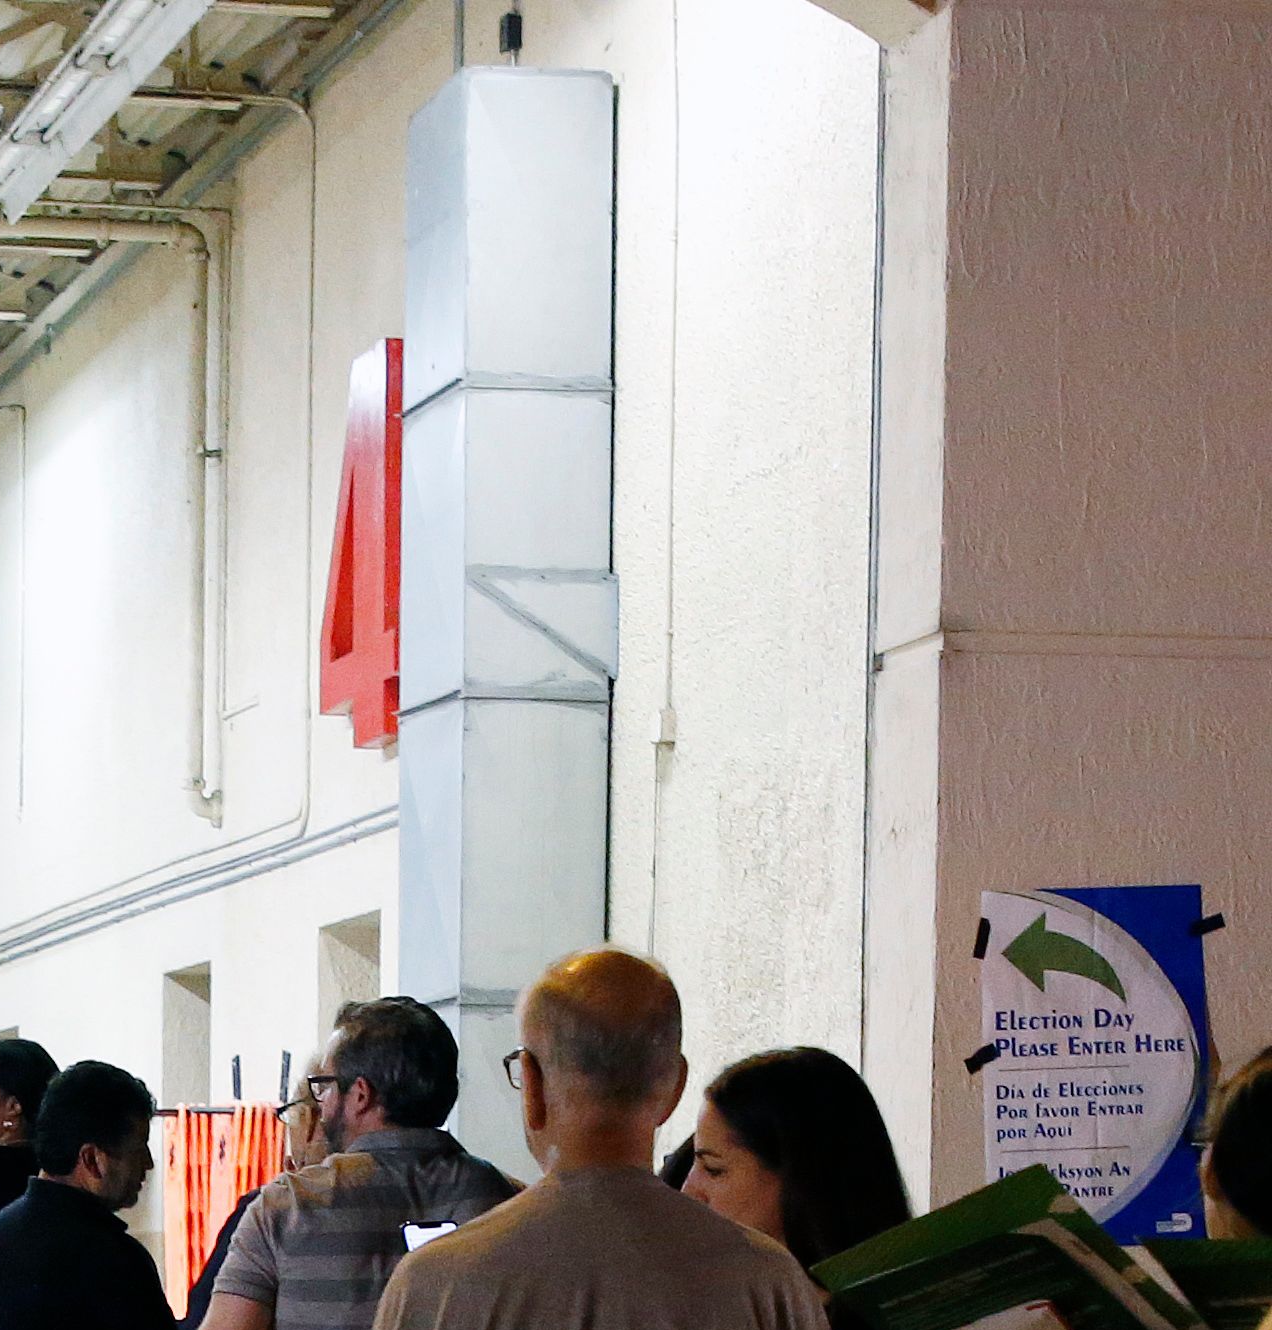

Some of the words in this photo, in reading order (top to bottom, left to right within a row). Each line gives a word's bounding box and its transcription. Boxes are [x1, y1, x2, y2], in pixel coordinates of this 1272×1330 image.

[995, 1010, 1083, 1031] Election
[1094, 1008, 1135, 1032] Day
[995, 1037, 1058, 1057] Please
[1068, 1036, 1126, 1055] Enter
[1135, 1034, 1186, 1053] Here
[1032, 1083, 1052, 1098] de
[1059, 1080, 1144, 1098] Elecciones
[996, 1104, 1028, 1119] Por
[1087, 1100, 1144, 1116] Entrar
[997, 1127, 1027, 1143] por
[1109, 1162, 1130, 1177] An
